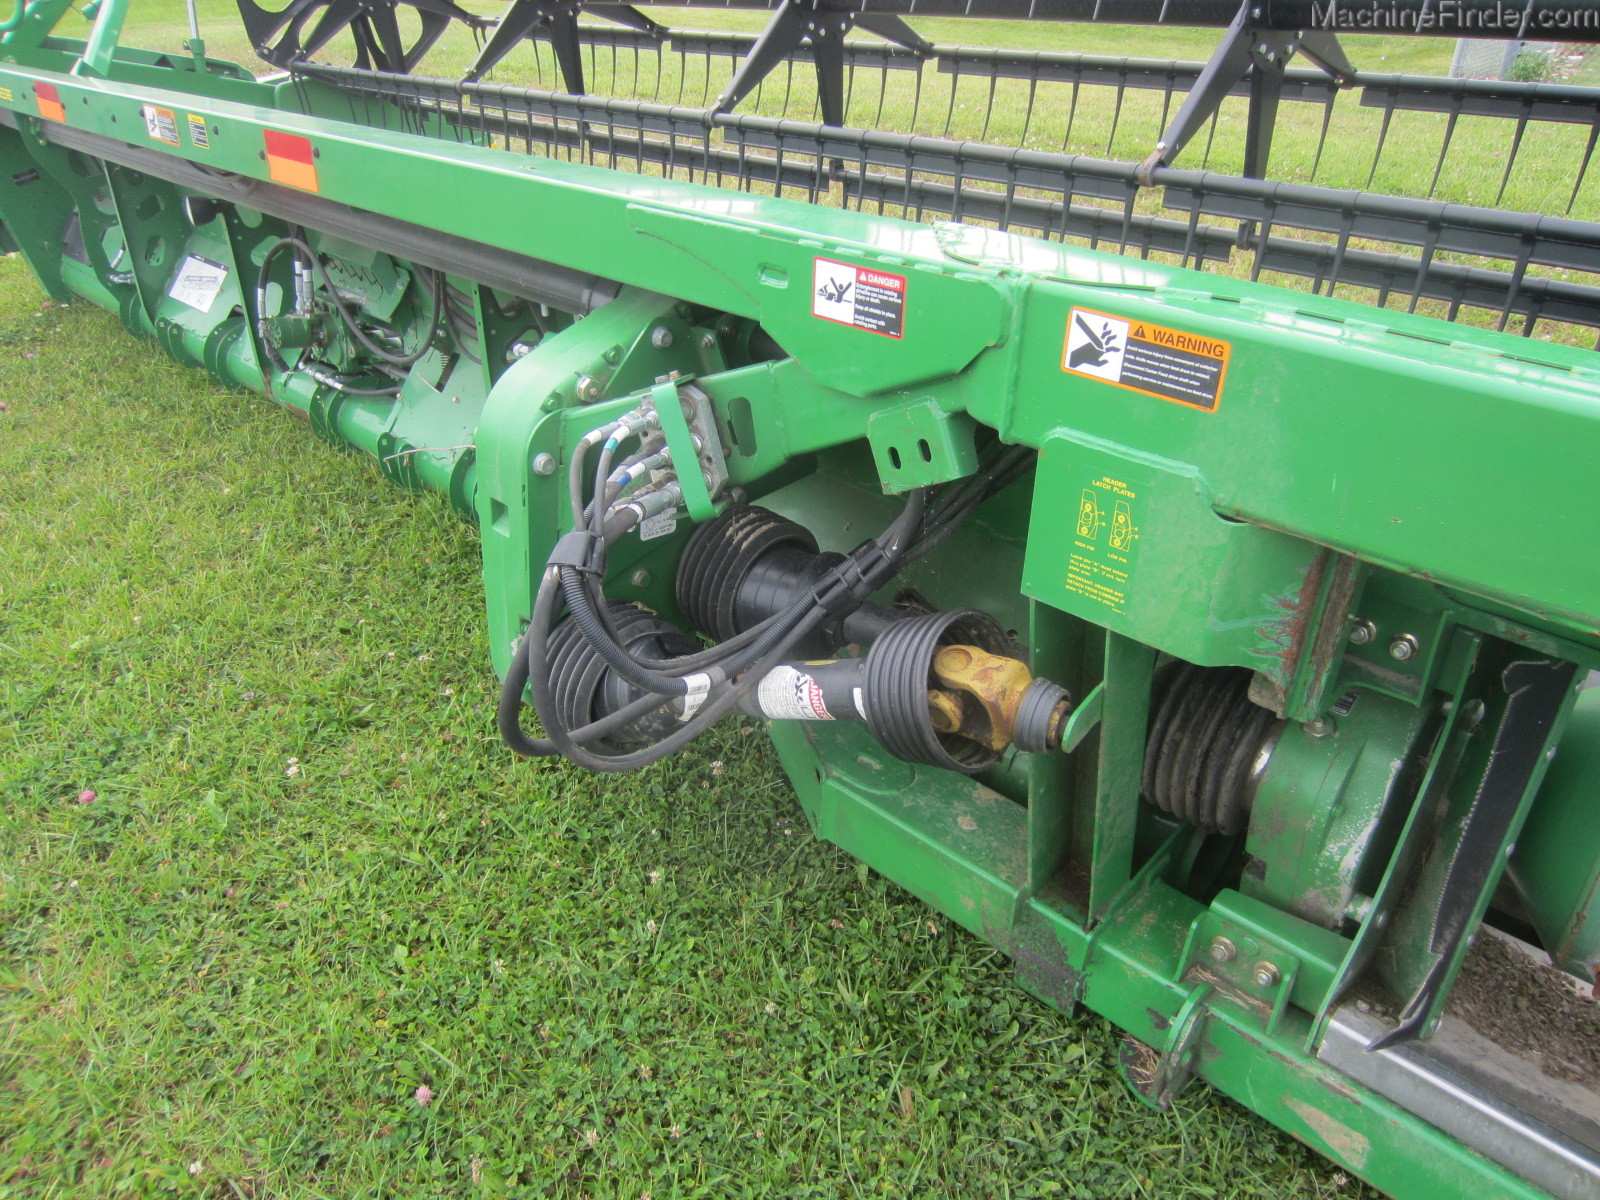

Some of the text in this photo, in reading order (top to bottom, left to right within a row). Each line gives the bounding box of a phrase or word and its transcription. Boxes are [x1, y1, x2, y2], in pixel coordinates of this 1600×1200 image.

[867, 274, 900, 289] DANGER
[1153, 328, 1224, 358] WARNING
[1124, 362, 1145, 371] Disconnect
[1174, 357, 1195, 366] movement
[1122, 371, 1143, 380] performing
[1162, 382, 1187, 391] maintenance
[1103, 476, 1127, 488] HEADER
[1092, 480, 1136, 498] LATCH PLATES
[1112, 569, 1129, 578] extend
[1066, 578, 1084, 588] DETACH
[1084, 585, 1098, 594] FROM
[1098, 591, 1120, 603] COMBINE
[1094, 583, 1114, 593] HEADER
